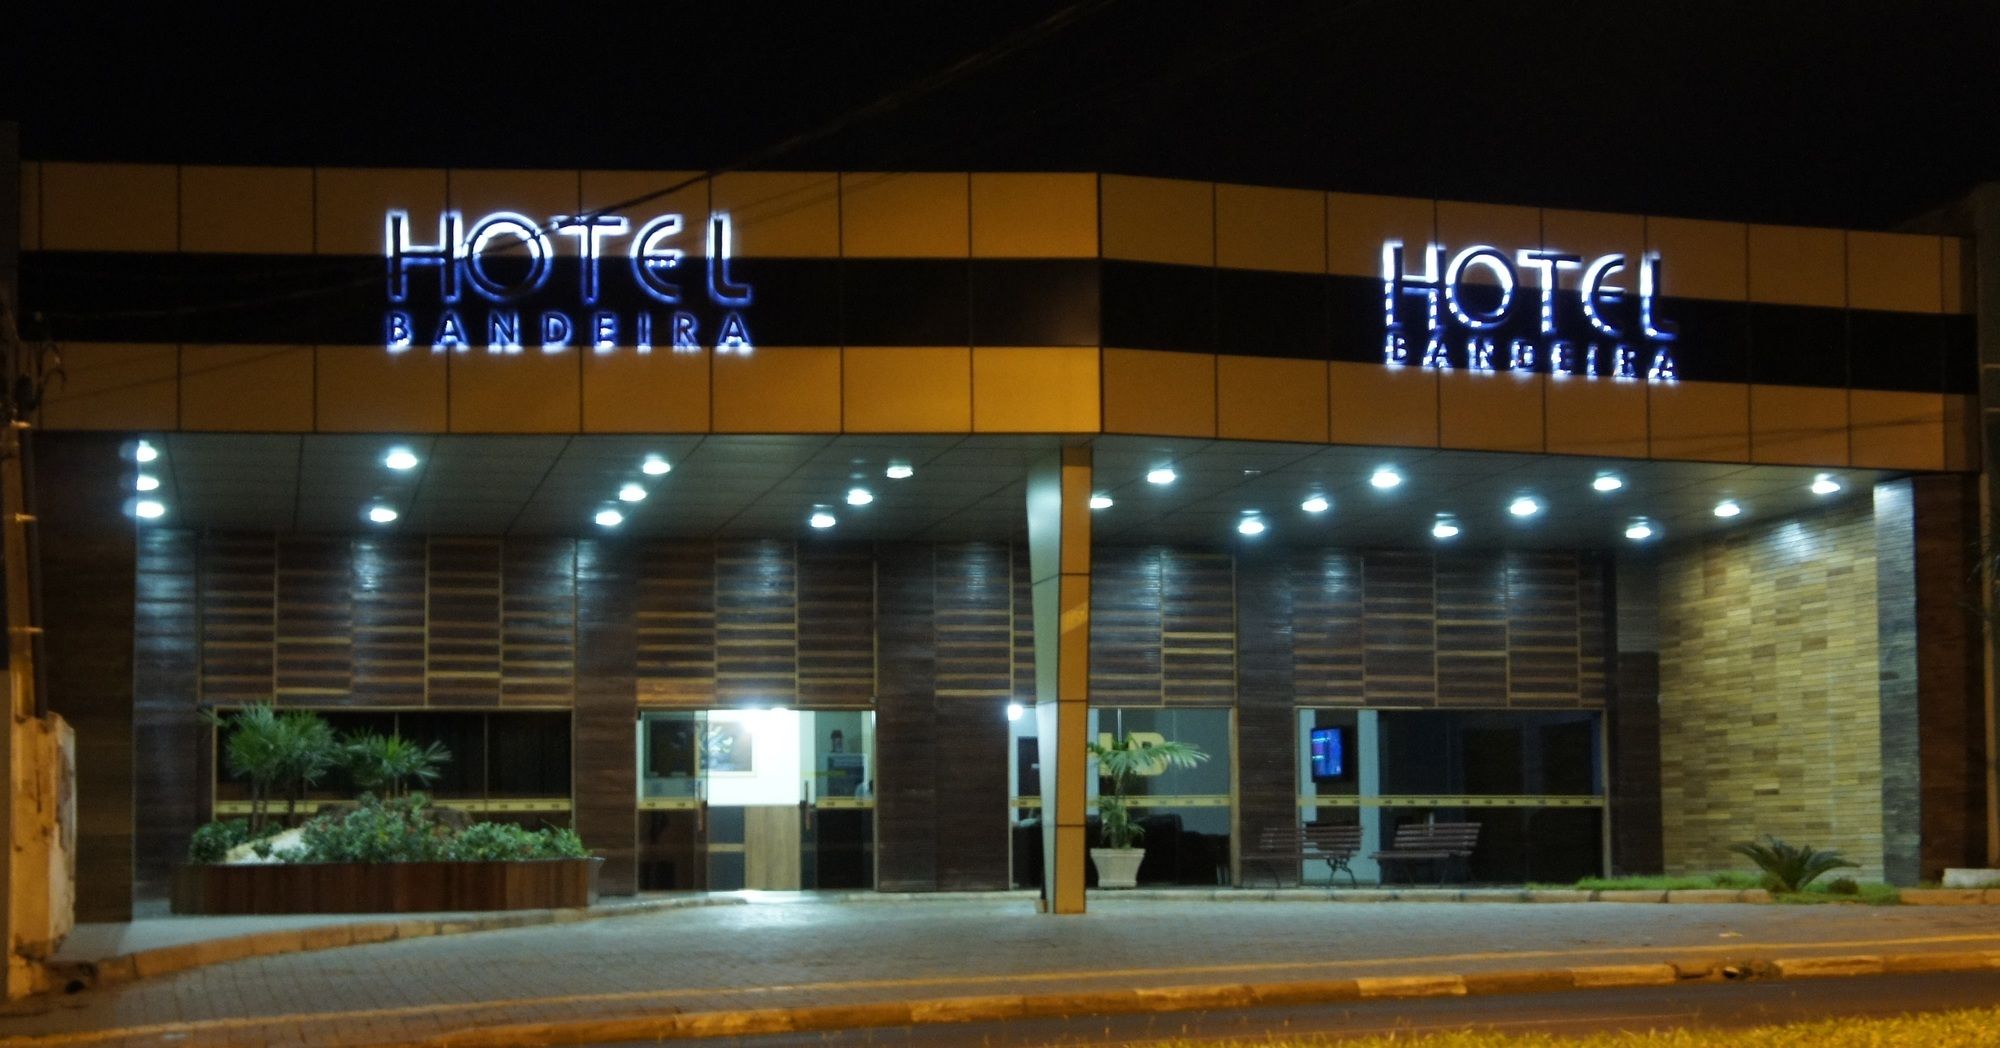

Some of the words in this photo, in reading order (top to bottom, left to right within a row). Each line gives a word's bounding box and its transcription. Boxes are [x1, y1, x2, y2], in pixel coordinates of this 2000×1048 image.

[385, 209, 753, 305] HOTEL
[1382, 240, 1678, 340] HOTEL
[385, 312, 755, 353] BANDEIRA
[1385, 334, 1680, 383] BANDEIRA
